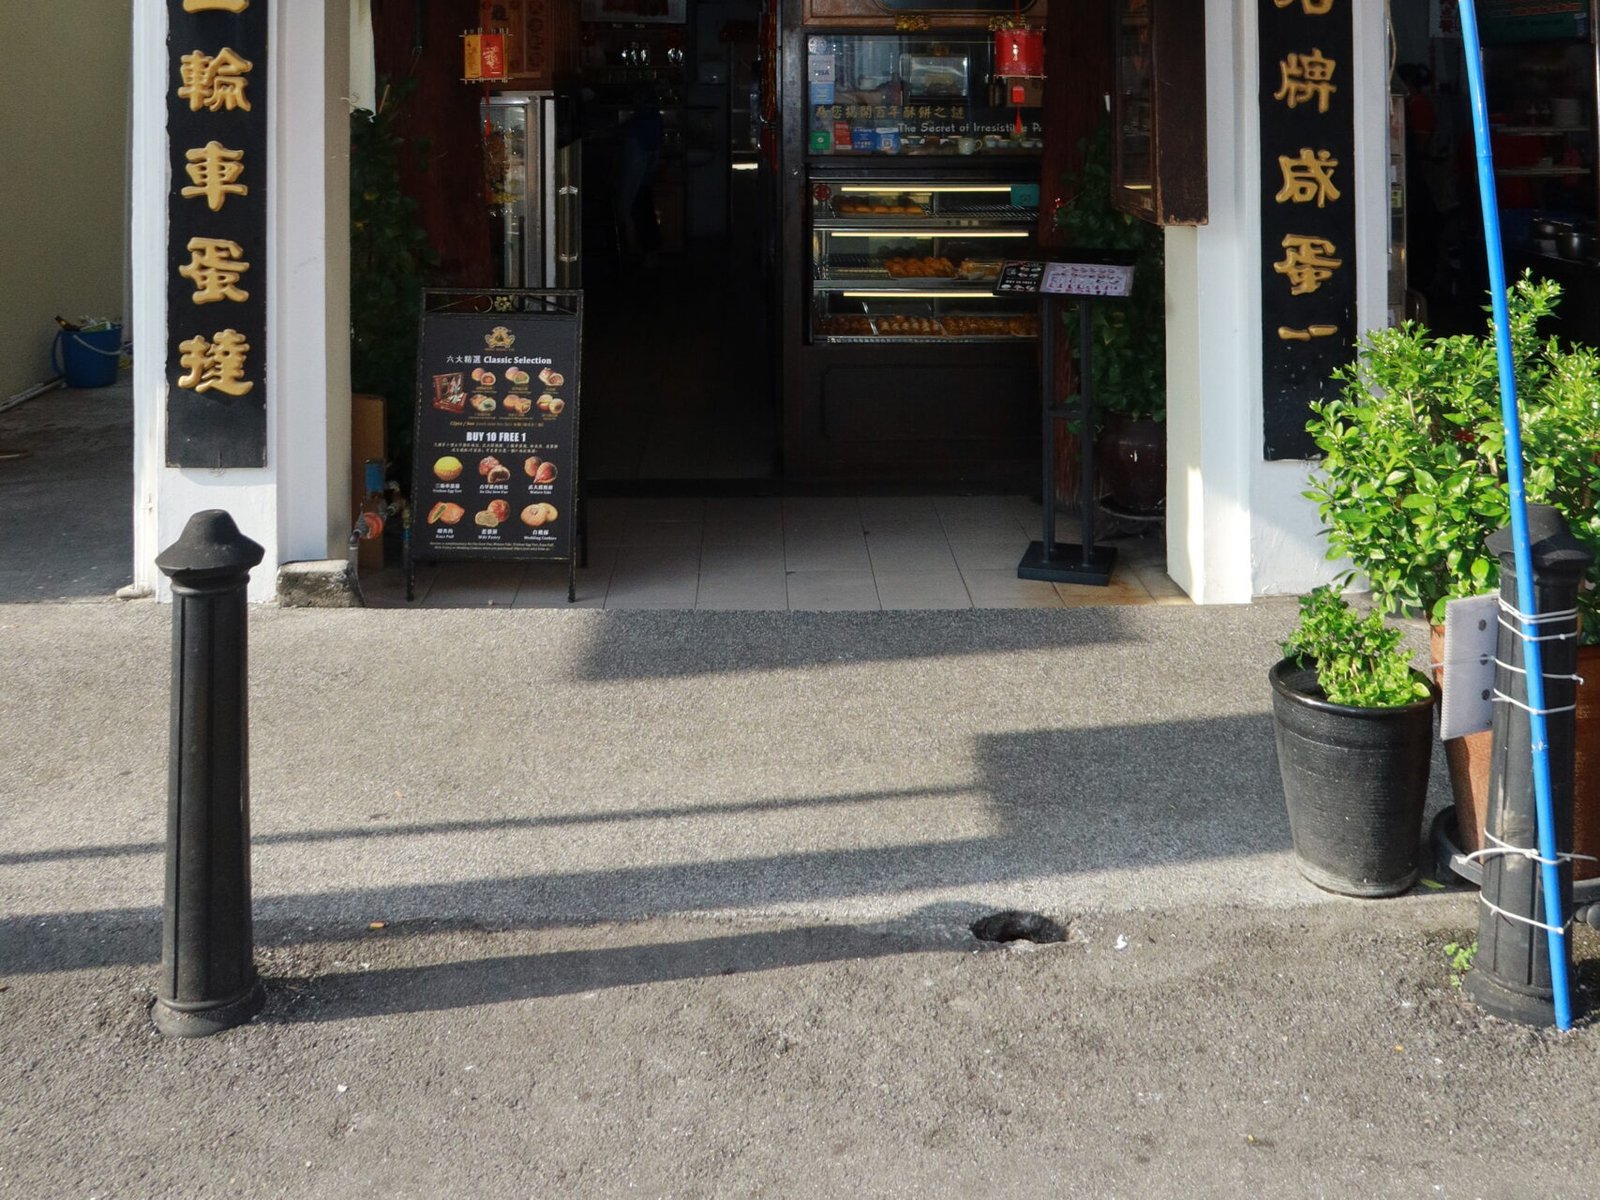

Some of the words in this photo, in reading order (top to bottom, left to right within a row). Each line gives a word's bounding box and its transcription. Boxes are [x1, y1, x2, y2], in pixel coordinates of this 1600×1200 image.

[898, 122, 917, 133] The
[921, 122, 956, 133] Secret
[959, 122, 970, 133] of
[483, 356, 513, 365] Classic
[513, 356, 552, 365] Selection
[466, 431, 485, 442] BUY
[486, 432, 497, 442] 10
[498, 432, 520, 443] FREE
[520, 432, 527, 443] 1
